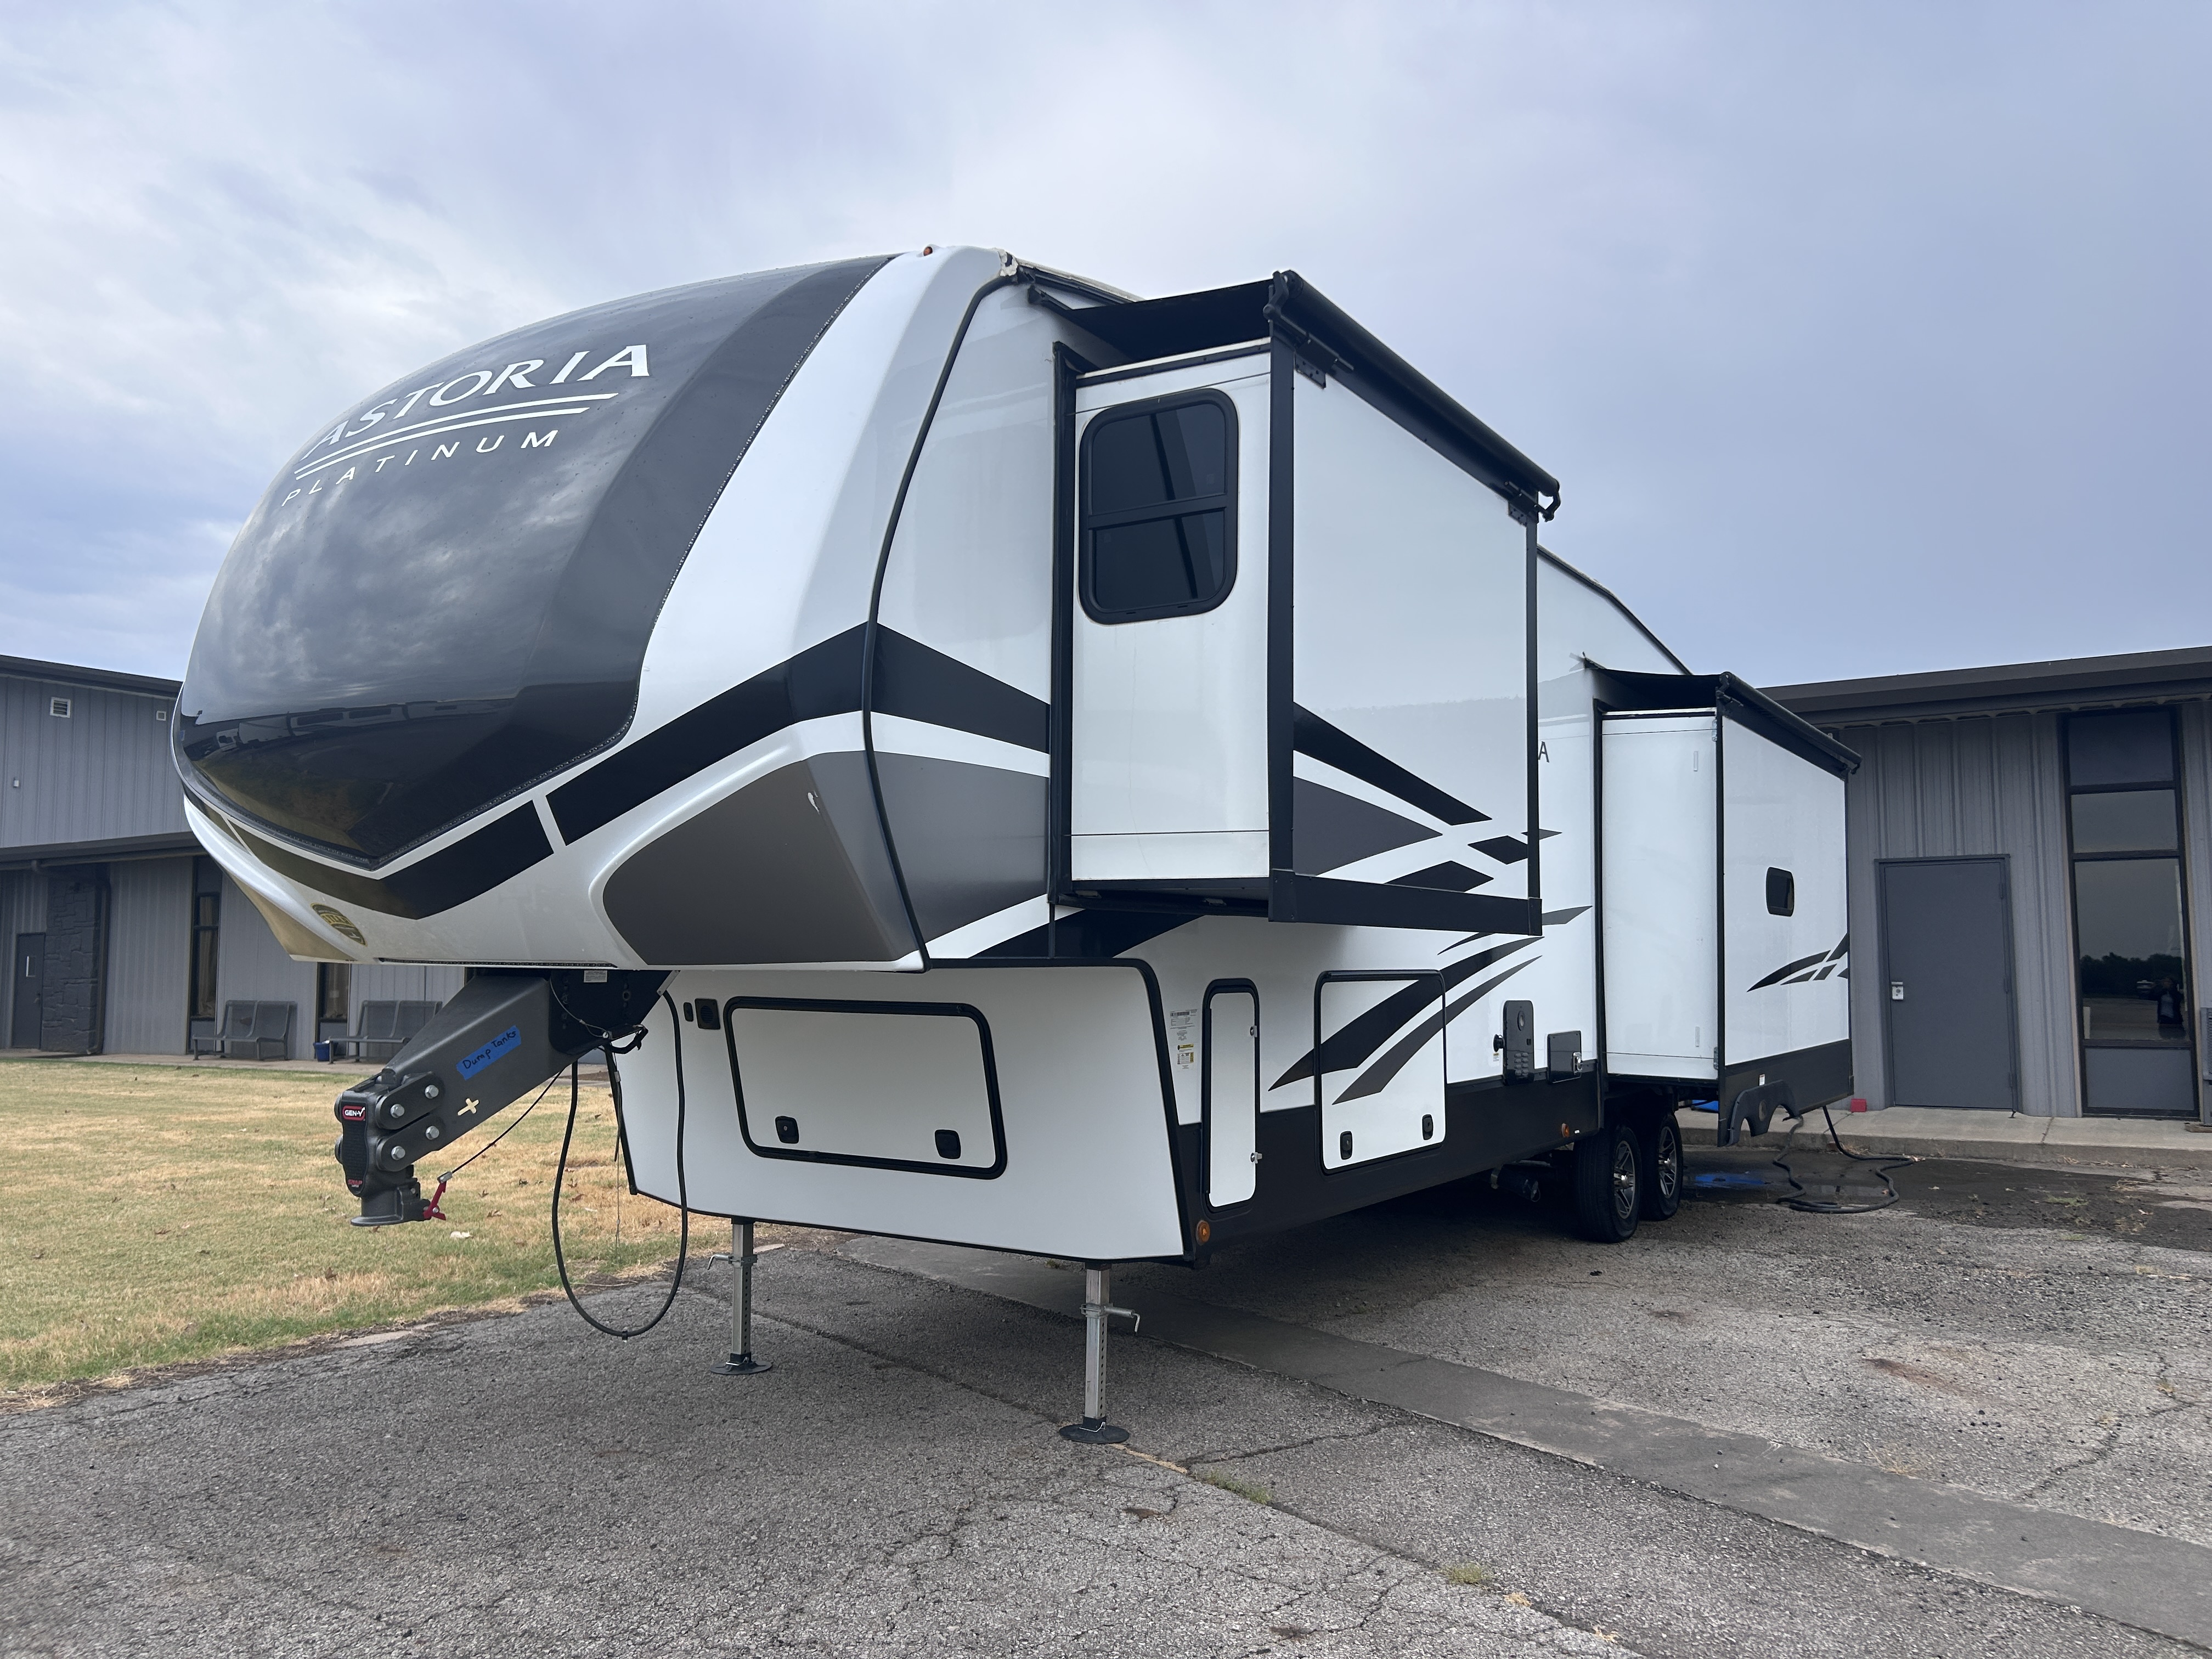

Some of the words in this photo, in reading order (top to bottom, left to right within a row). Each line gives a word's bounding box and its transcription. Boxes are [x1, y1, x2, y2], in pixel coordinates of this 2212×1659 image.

[301, 344, 650, 461] ASTORIA
[281, 430, 558, 506] PLATINUM
[462, 1048, 491, 1069] Dump
[491, 1031, 516, 1047] Tanks
[345, 1107, 366, 1117] GEN-Y
